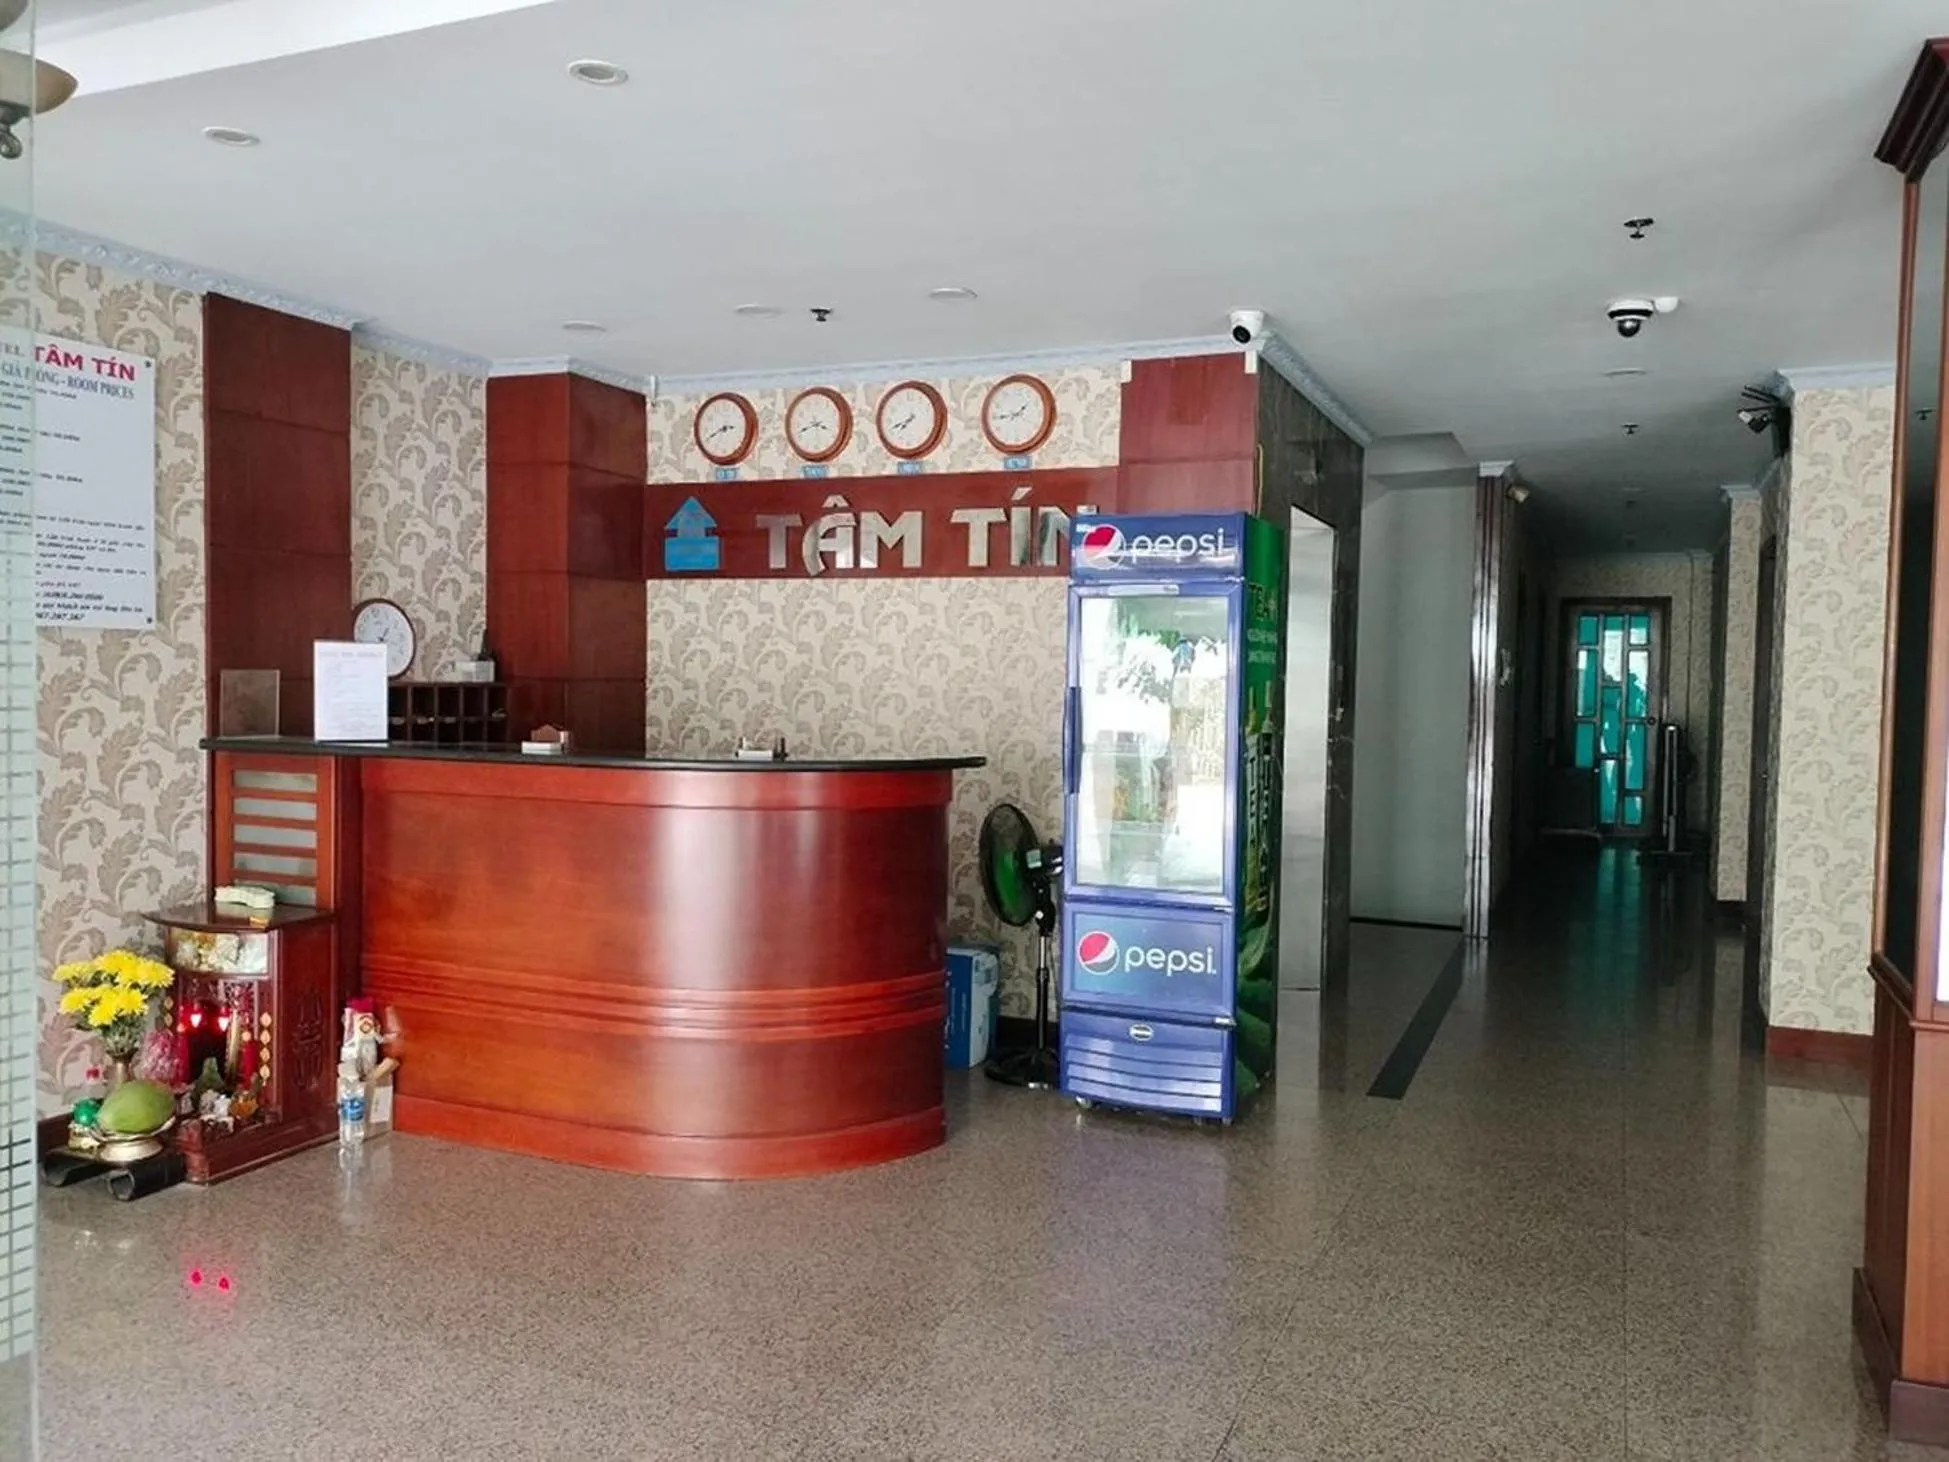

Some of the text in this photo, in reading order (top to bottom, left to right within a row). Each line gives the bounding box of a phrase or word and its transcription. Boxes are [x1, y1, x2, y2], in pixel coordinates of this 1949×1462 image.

[34, 343, 83, 370] TÂM
[91, 356, 135, 381] TÍN
[755, 494, 923, 577] TÂM
[1131, 527, 1225, 564] pepsi
[1123, 944, 1214, 977] pepsi
